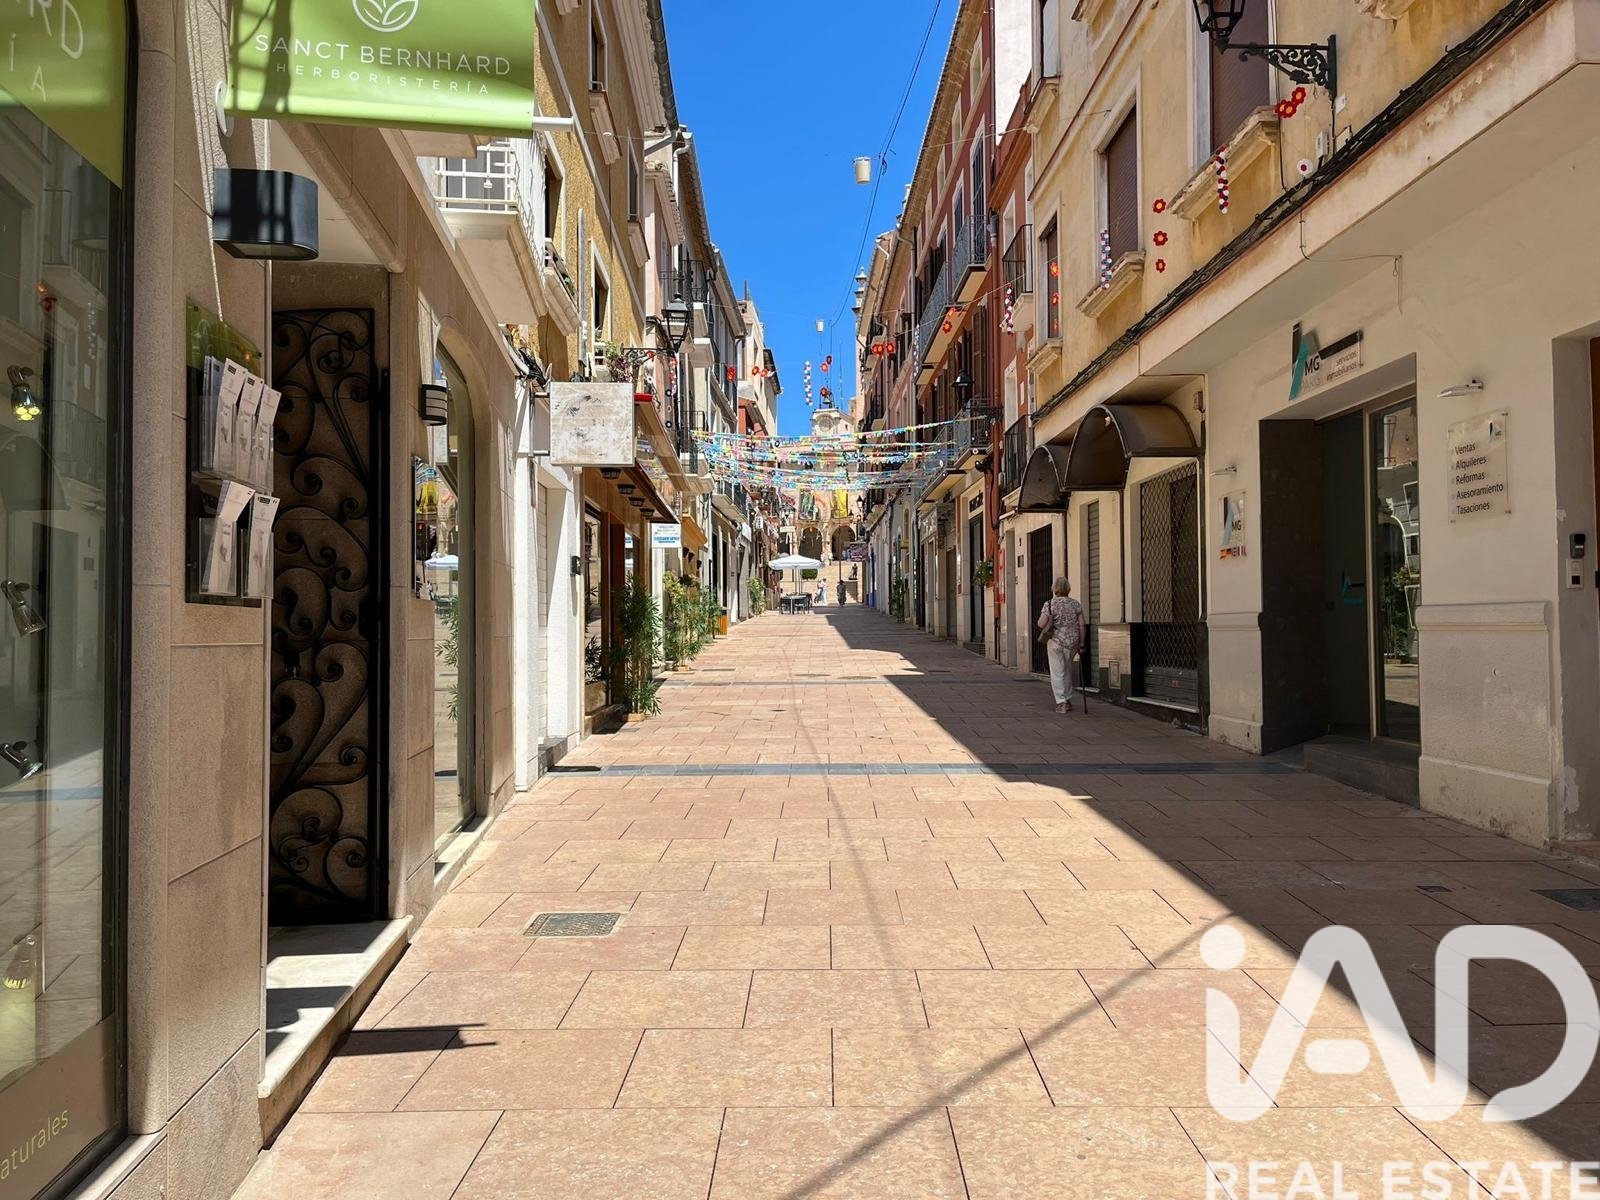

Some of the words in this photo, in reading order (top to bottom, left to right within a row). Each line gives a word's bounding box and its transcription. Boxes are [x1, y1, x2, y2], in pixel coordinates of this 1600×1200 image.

[255, 34, 349, 61] SANCT
[360, 45, 511, 75] BERNHARD
[276, 63, 489, 95] HERBORISTERÍA
[1455, 443, 1476, 455] Ventas
[1456, 456, 1487, 470] Alquileres
[1456, 471, 1485, 485] Reformas
[1456, 483, 1504, 500] Asesoramiento
[1457, 502, 1490, 515] Tasaciones
